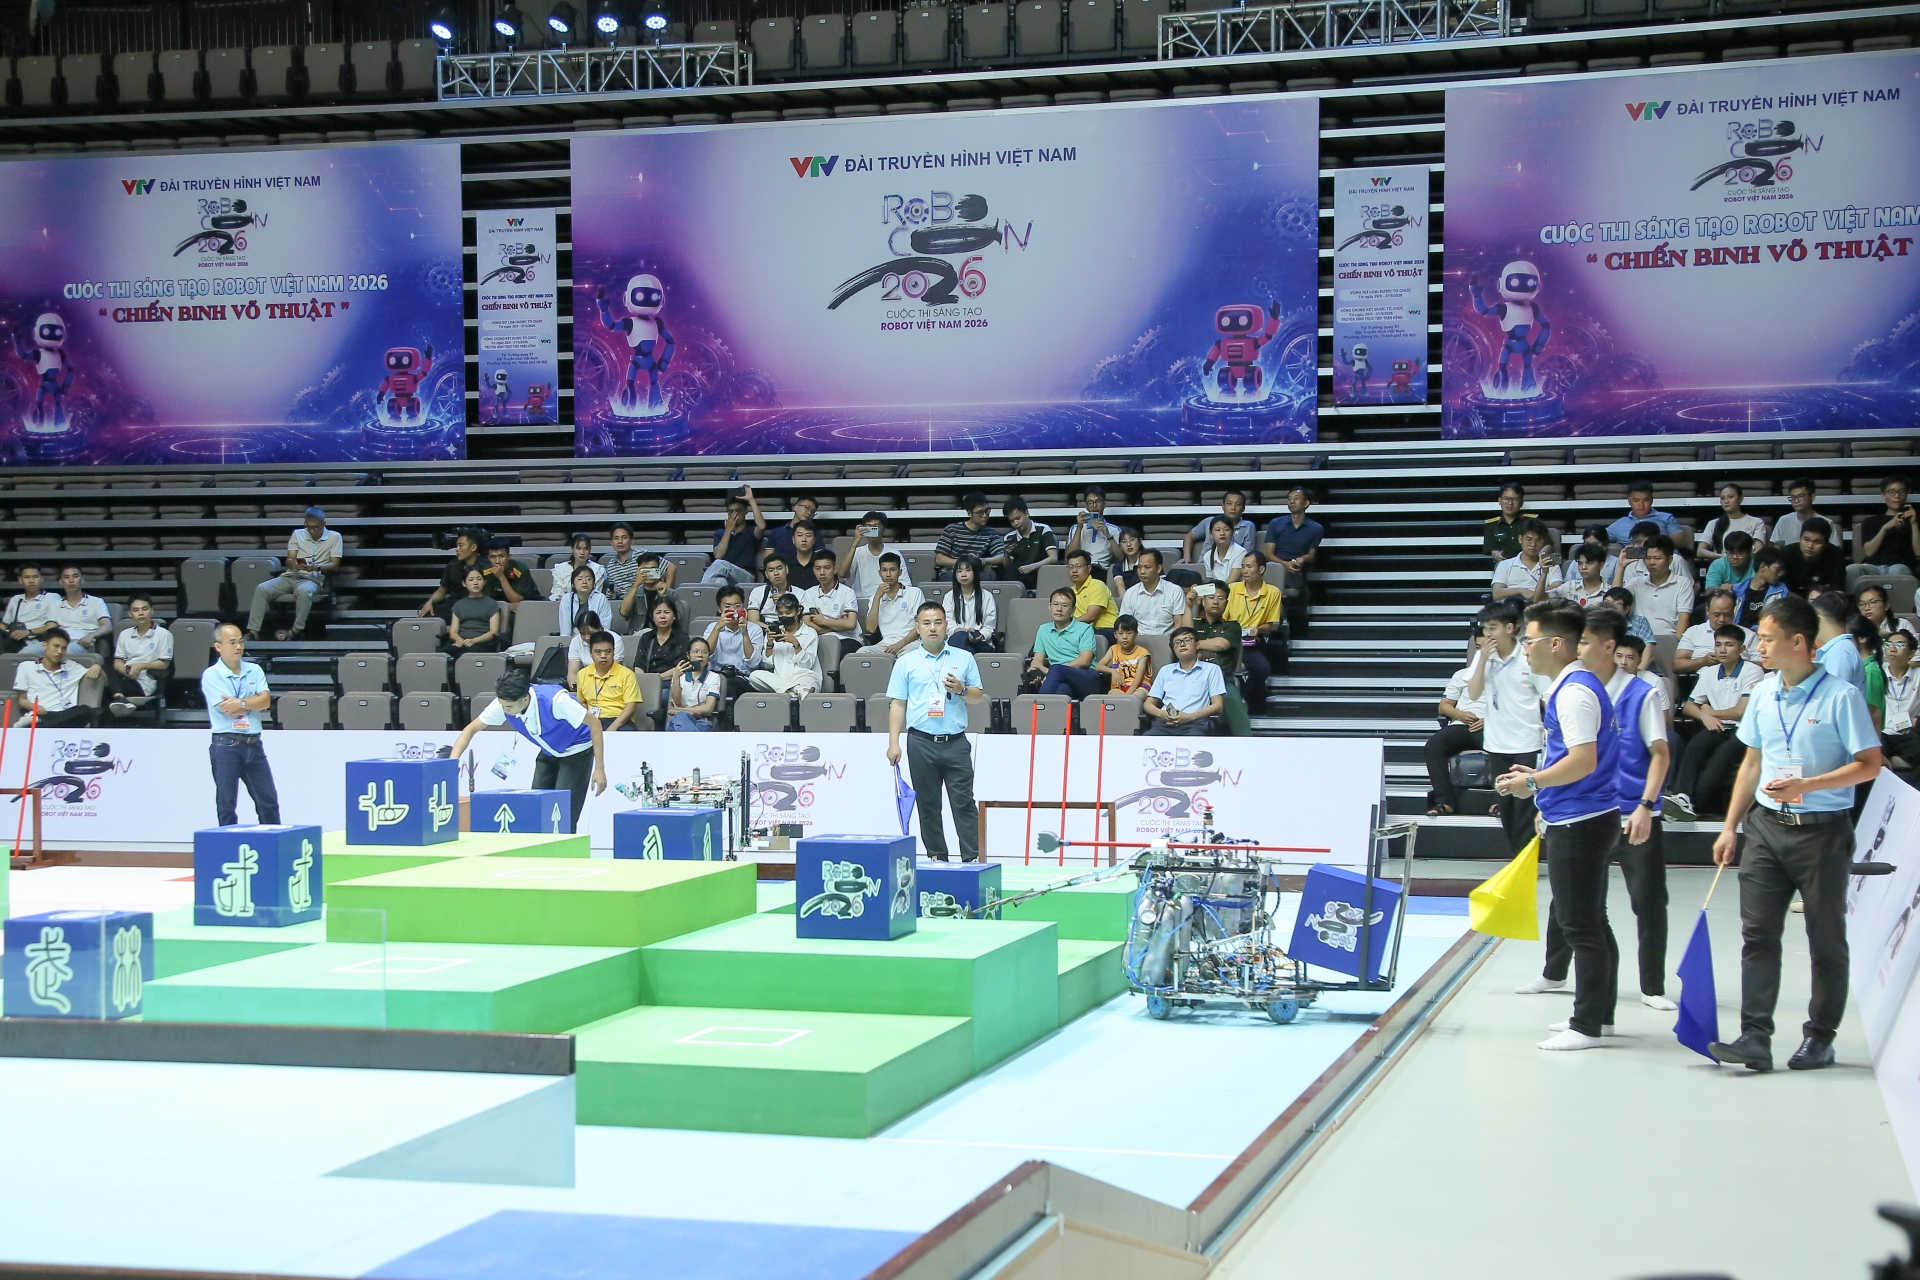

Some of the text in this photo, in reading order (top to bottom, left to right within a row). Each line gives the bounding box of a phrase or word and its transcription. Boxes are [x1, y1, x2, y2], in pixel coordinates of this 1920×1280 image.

[1625, 87, 1900, 122] VTV ĐÀI TRUYỀN HÌNH VIỆT NAM
[789, 146, 1077, 178] VTV ĐÀI TRUYỀN HÌNH VIỆT NAM
[122, 174, 321, 196] VTV ĐÀI TRUYỀN HÌNH VIỆT NAM
[1370, 177, 1392, 187] VTV
[1747, 195, 1760, 203] VIỆT
[506, 218, 525, 227] VTV
[1539, 220, 1594, 248] CUỘC
[1599, 220, 1630, 242] THI
[1635, 214, 1690, 240] SÁNG
[1695, 215, 1738, 241] TẠO
[1743, 211, 1817, 235] ROBOT
[1823, 205, 1869, 233] VIỆT
[1605, 242, 1688, 270] CHIẾN
[1693, 246, 1760, 267] BINH
[1767, 238, 1808, 262] VÕ
[1815, 233, 1914, 262] THUẬT
[1338, 269, 1362, 279] CHIẾN
[1363, 270, 1383, 278] BINH
[1396, 267, 1424, 278] THUẬT
[63, 273, 389, 303] CUỘC THI SÁNG TẠO ROBOT VIỆT NAM 2026
[112, 299, 173, 323] CHIẾN
[178, 303, 227, 321] BINH
[230, 300, 261, 320] VÕ
[265, 298, 336, 322] THUẬT
[886, 305, 983, 320] CUỘC THI SÁNG TẠO
[880, 318, 988, 332] ROBOT VIỆT NAM 2026
